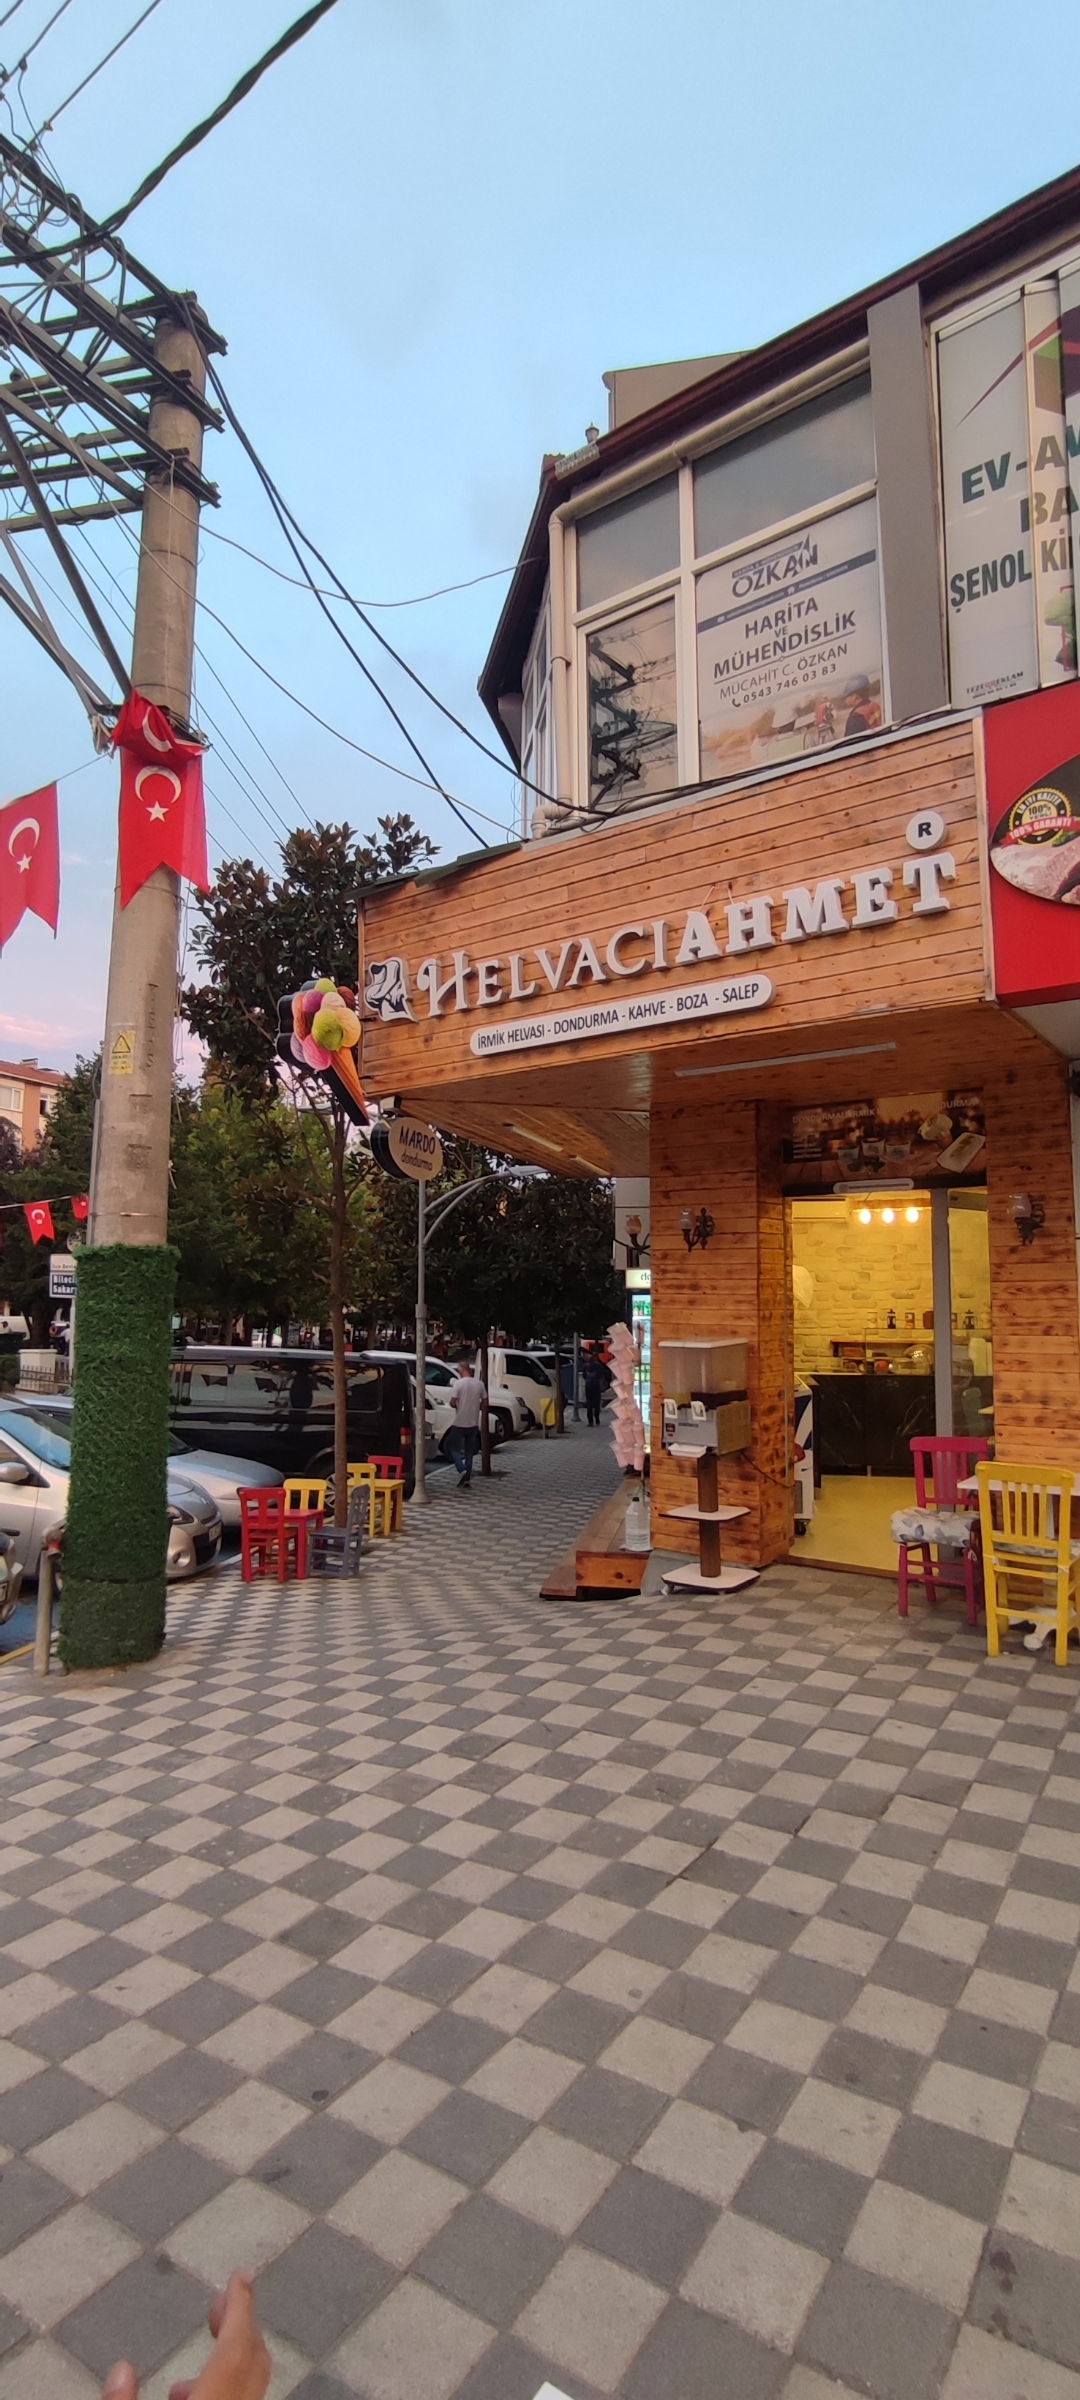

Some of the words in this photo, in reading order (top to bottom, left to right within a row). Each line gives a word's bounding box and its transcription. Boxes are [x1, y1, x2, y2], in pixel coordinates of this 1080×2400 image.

[732, 541, 818, 598] ÖZKAN
[951, 549, 1032, 614] ŞENOL
[745, 597, 818, 639] HARİTA
[774, 626, 789, 638] VE
[714, 610, 856, 678] MÜHENDİSLİK
[720, 668, 778, 699] MÜCAHİT
[782, 665, 794, 677] C.
[798, 643, 848, 671] ÖZKAN
[744, 686, 772, 703] 0543
[776, 675, 799, 692] 746
[802, 670, 817, 682] 03
[822, 663, 836, 676] 83
[477, 1030, 505, 1050] İRMİK
[507, 1024, 545, 1044] HELVASI
[554, 1009, 619, 1034] DONDURMA
[628, 1001, 666, 1021] KAHVE
[677, 993, 709, 1012] BOZA
[722, 983, 760, 1003] SALEP
[399, 1125, 436, 1155] MARDO
[401, 1149, 433, 1171] dondurma
[53, 1275, 76, 1284] Bileci
[53, 1285, 76, 1294] Sakar
